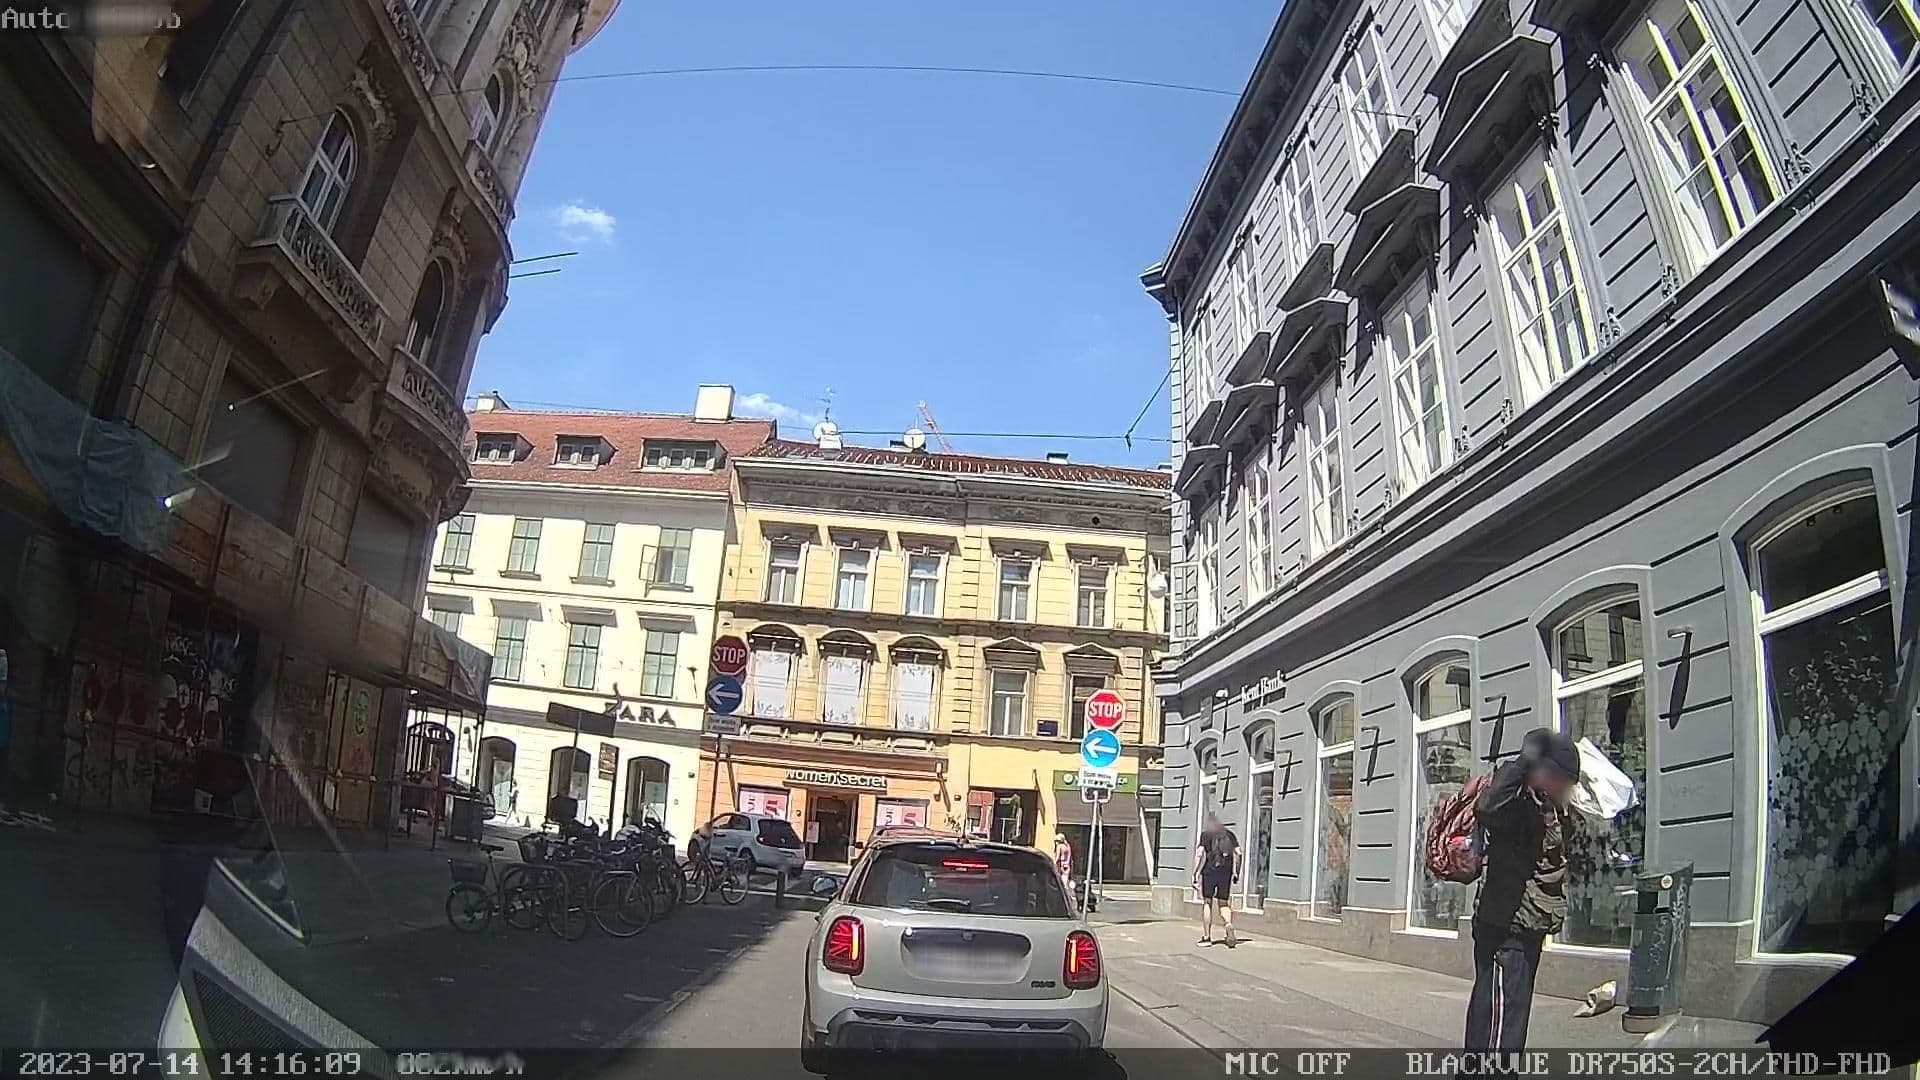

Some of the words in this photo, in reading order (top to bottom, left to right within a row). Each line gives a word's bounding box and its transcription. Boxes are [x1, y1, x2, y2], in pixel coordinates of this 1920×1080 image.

[712, 646, 746, 664] STOP
[604, 702, 677, 728] ZARA
[1088, 701, 1123, 719] STOP
